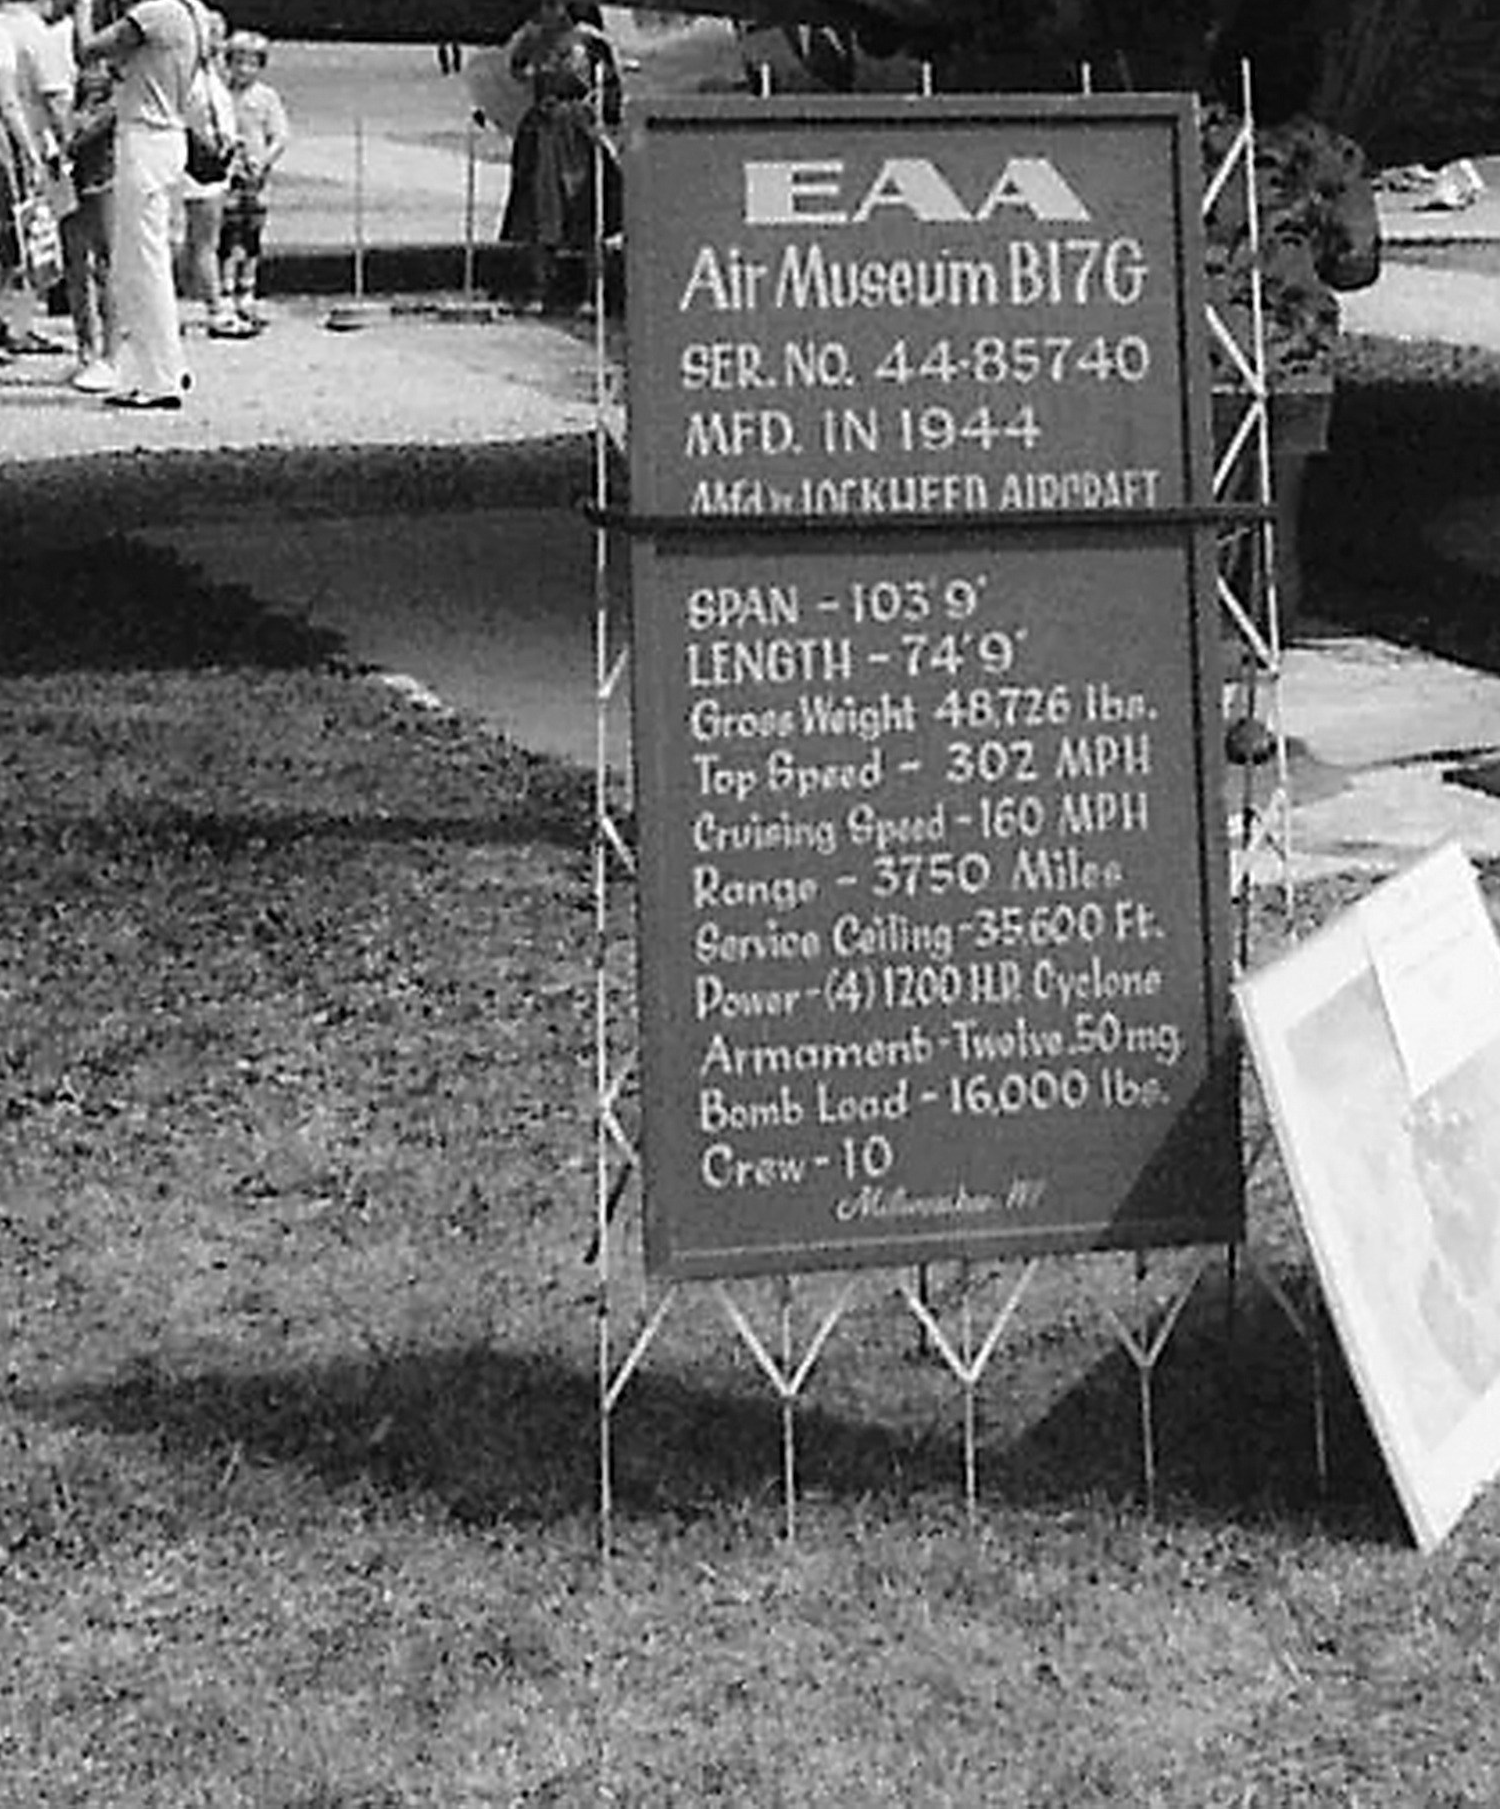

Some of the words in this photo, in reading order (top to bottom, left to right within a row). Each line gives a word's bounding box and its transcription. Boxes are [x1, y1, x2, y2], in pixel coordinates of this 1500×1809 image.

[744, 158, 1092, 224] EAA
[679, 245, 767, 311] Air
[775, 242, 998, 308] Museum
[1009, 236, 1149, 306] B17G
[681, 342, 777, 389] SER.
[785, 341, 855, 387] NO.
[874, 335, 1150, 384] 44-85740
[686, 409, 803, 458] MFD.
[824, 406, 877, 454] IN
[902, 405, 1042, 451] 1944
[687, 584, 799, 631] SPAN
[686, 637, 852, 687] LENGTH
[690, 698, 795, 744] Gross
[798, 692, 917, 742] Weight
[692, 751, 757, 802] Top
[766, 745, 883, 798] Speed
[946, 739, 1039, 784] 302
[1054, 732, 1150, 778] MPH
[692, 809, 838, 856] Cruising
[847, 801, 946, 851] Speed
[980, 795, 1047, 839] 160
[1058, 791, 1149, 838] MPH
[693, 863, 819, 912] Range
[871, 851, 992, 896] 3750
[1010, 845, 1124, 892] Miles
[695, 918, 821, 965] Service
[1114, 898, 1167, 942] Ft.
[695, 973, 801, 1020] Power
[1033, 954, 1163, 1011] Cyclone
[699, 1024, 934, 1077] Armament
[700, 1084, 804, 1132] Bomb
[817, 1077, 909, 1124] Load
[702, 1143, 805, 1188] Crew
[843, 1134, 894, 1181] 10
